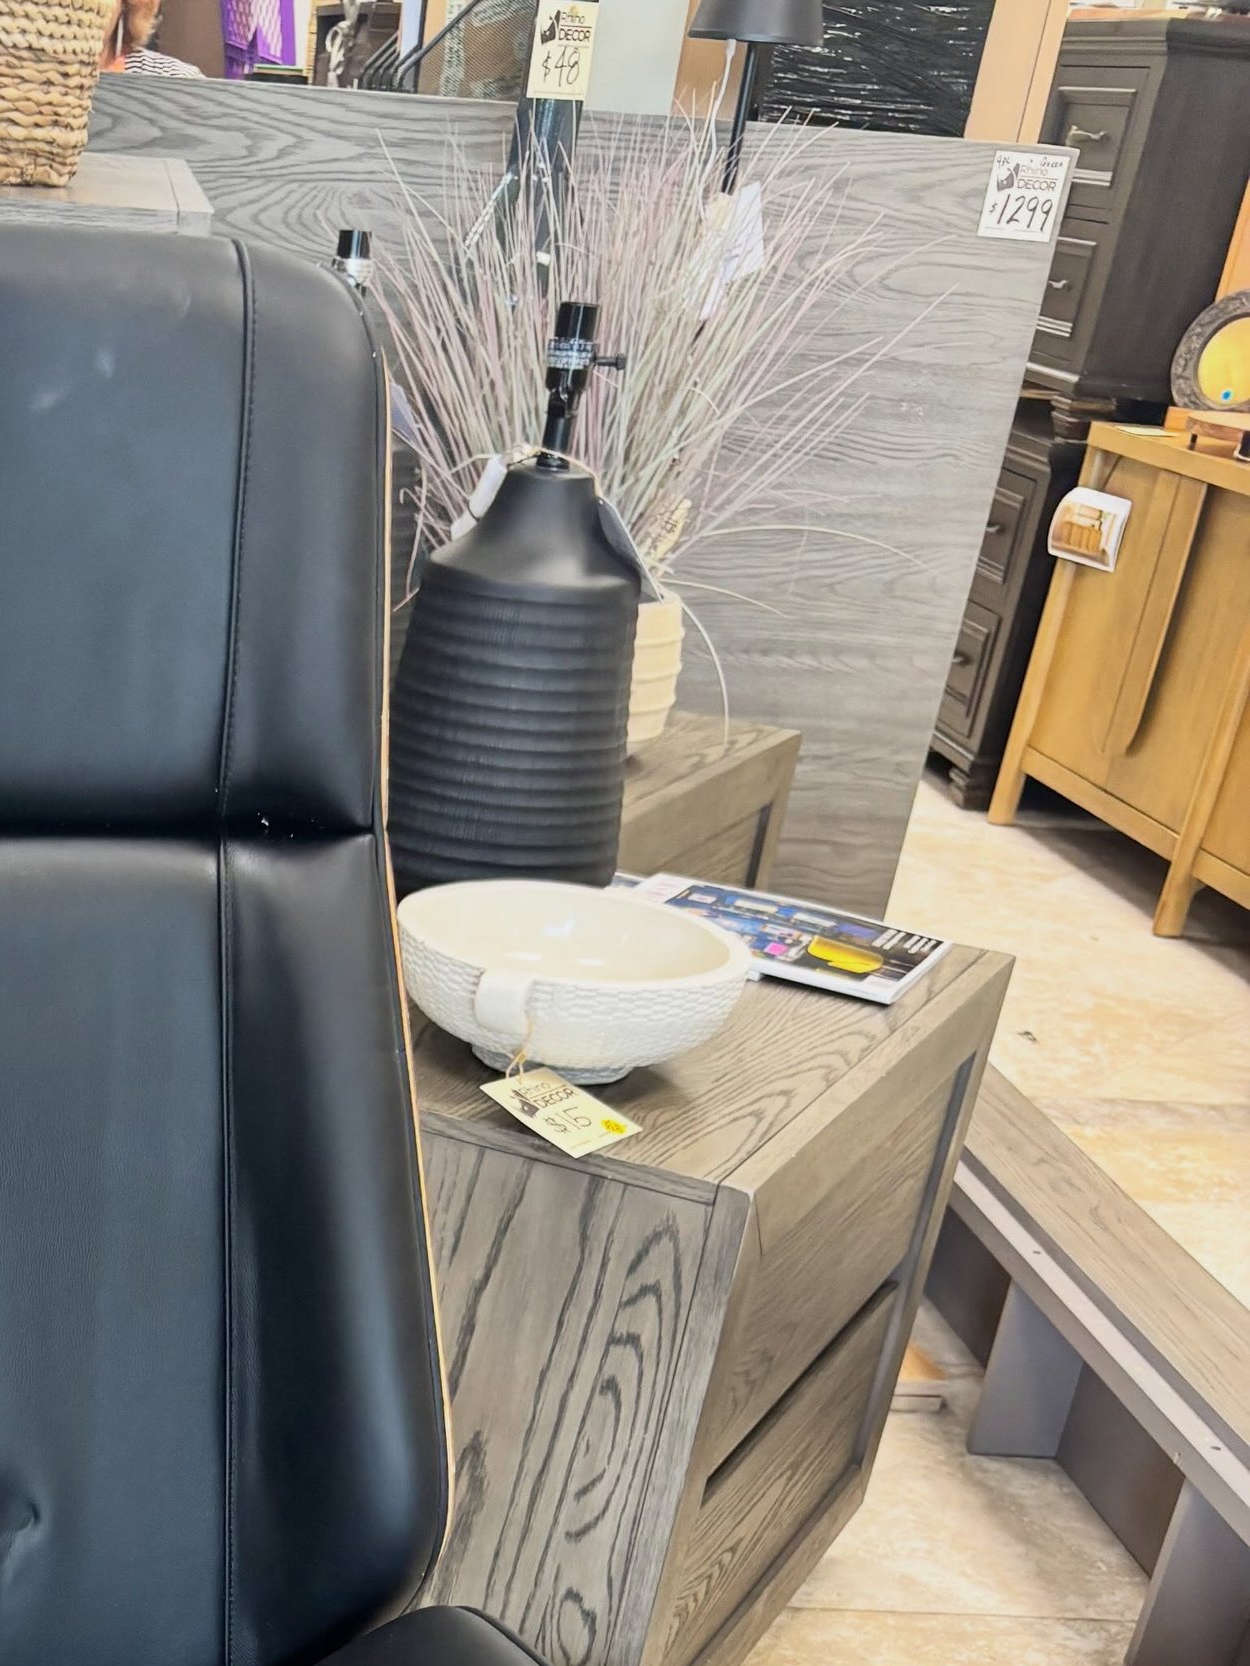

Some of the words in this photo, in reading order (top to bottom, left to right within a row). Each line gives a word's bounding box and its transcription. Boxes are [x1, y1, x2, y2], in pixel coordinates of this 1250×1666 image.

[558, 28, 591, 42] DECOR
[1017, 179, 1056, 191] DECOR
[535, 1088, 577, 1110] DECOR
